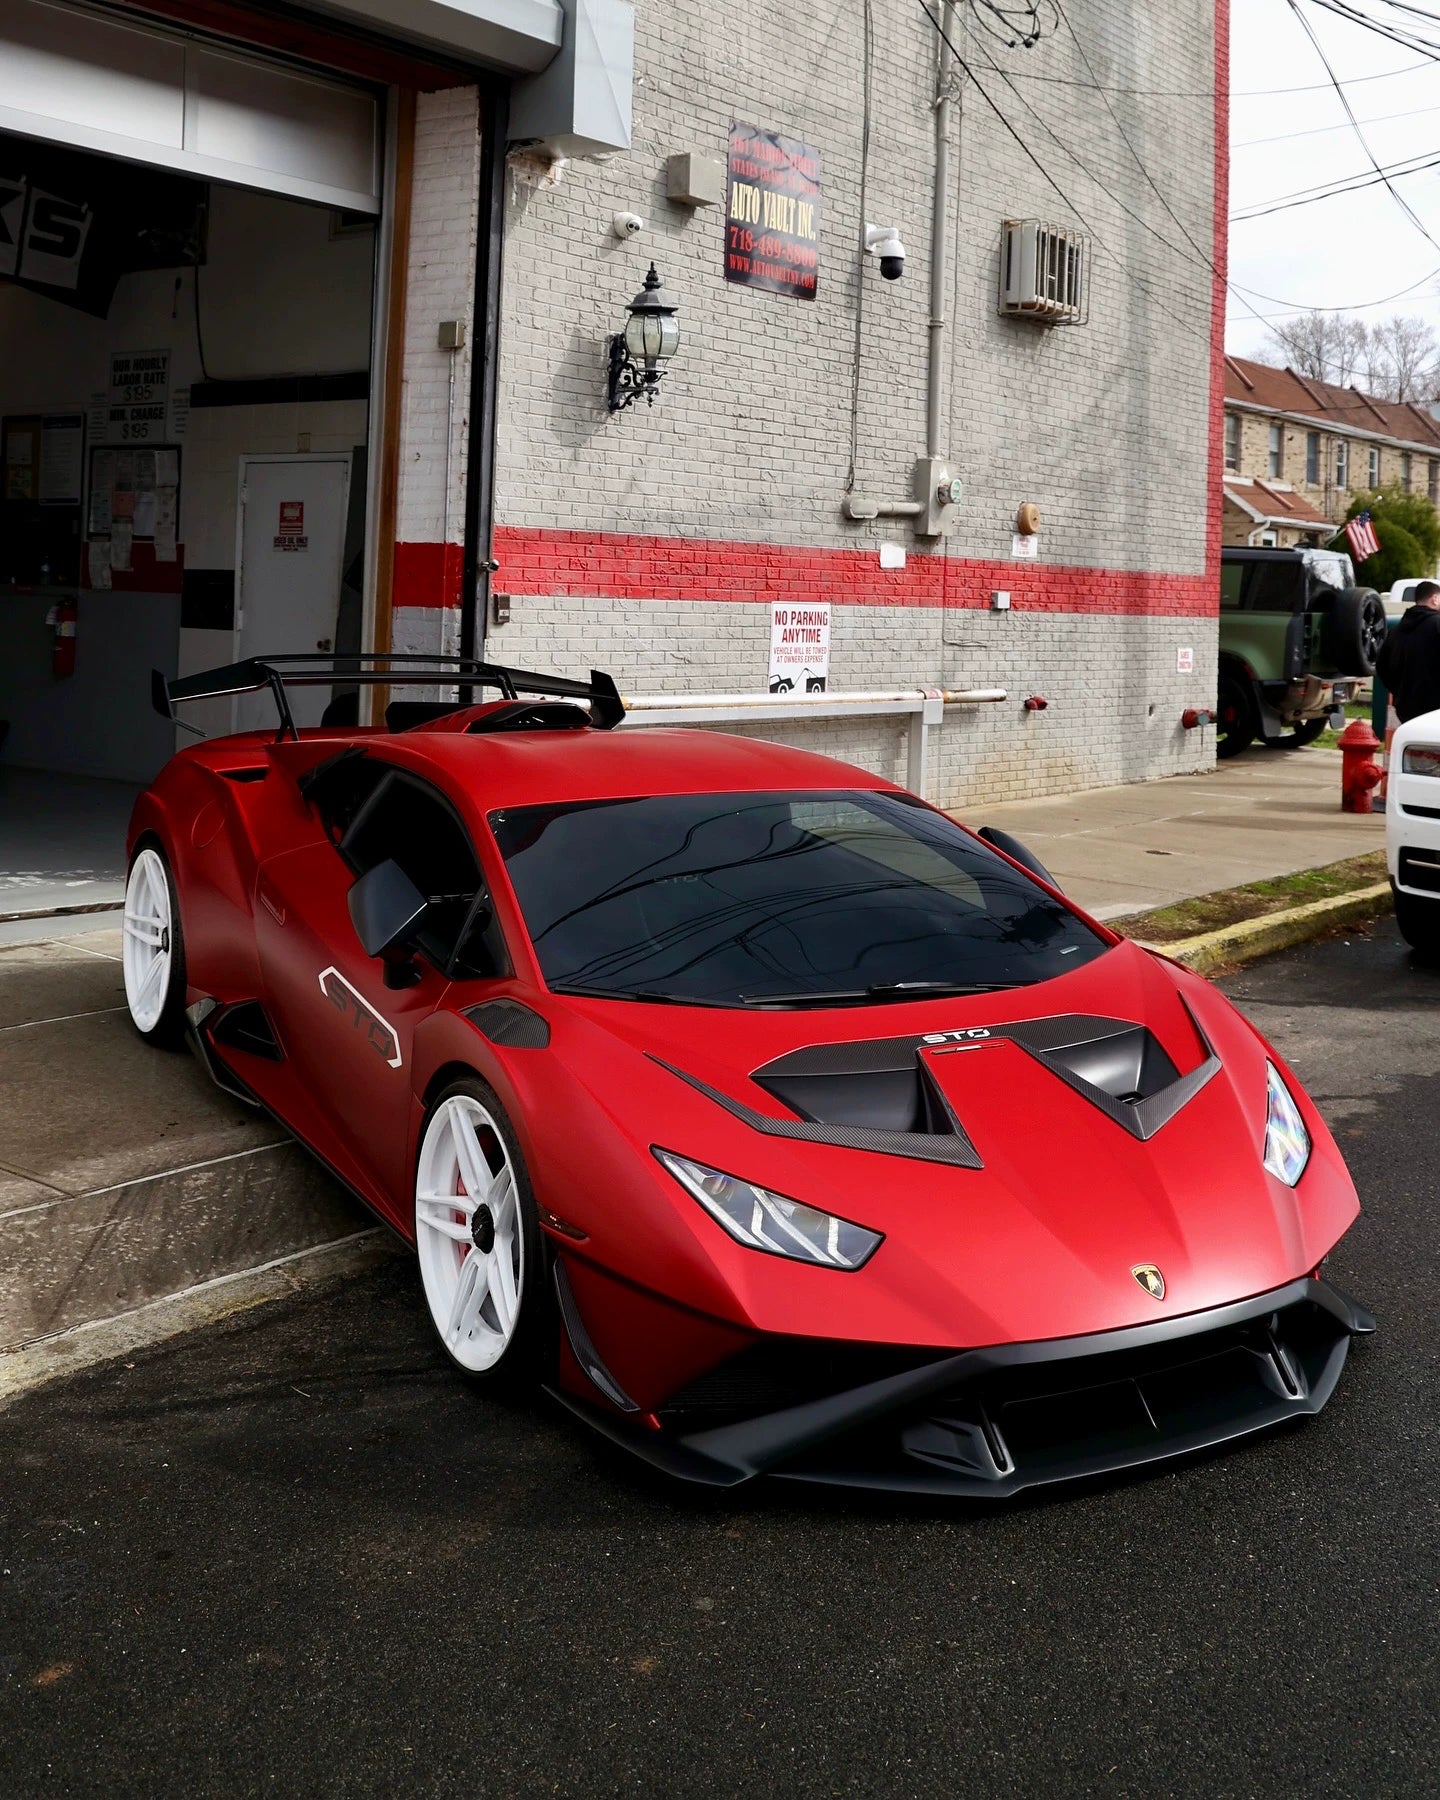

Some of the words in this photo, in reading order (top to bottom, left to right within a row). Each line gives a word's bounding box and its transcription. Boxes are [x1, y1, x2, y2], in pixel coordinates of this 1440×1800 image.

[730, 181, 760, 225] AUTO
[763, 190, 796, 234] VAULT
[797, 201, 816, 241] INC.
[112, 359, 130, 372] OUR
[133, 357, 167, 371] HOURLY
[112, 373, 141, 387] LABOR
[143, 372, 166, 384] RATE
[110, 409, 128, 421] MIN.
[130, 407, 164, 421] CHARGE
[775, 611, 788, 625] NO
[791, 611, 828, 625] PARKING
[782, 628, 821, 643] ANYTIME
[774, 646, 792, 654] VEHICLE
[793, 646, 804, 655] WILL
[805, 646, 811, 655] BE
[812, 646, 827, 655] TOWED
[776, 655, 783, 663] AT
[784, 655, 803, 663] OWNERS
[805, 655, 823, 663] EXPENSE
[327, 978, 392, 1058] STO
[922, 1028, 991, 1044] STO
